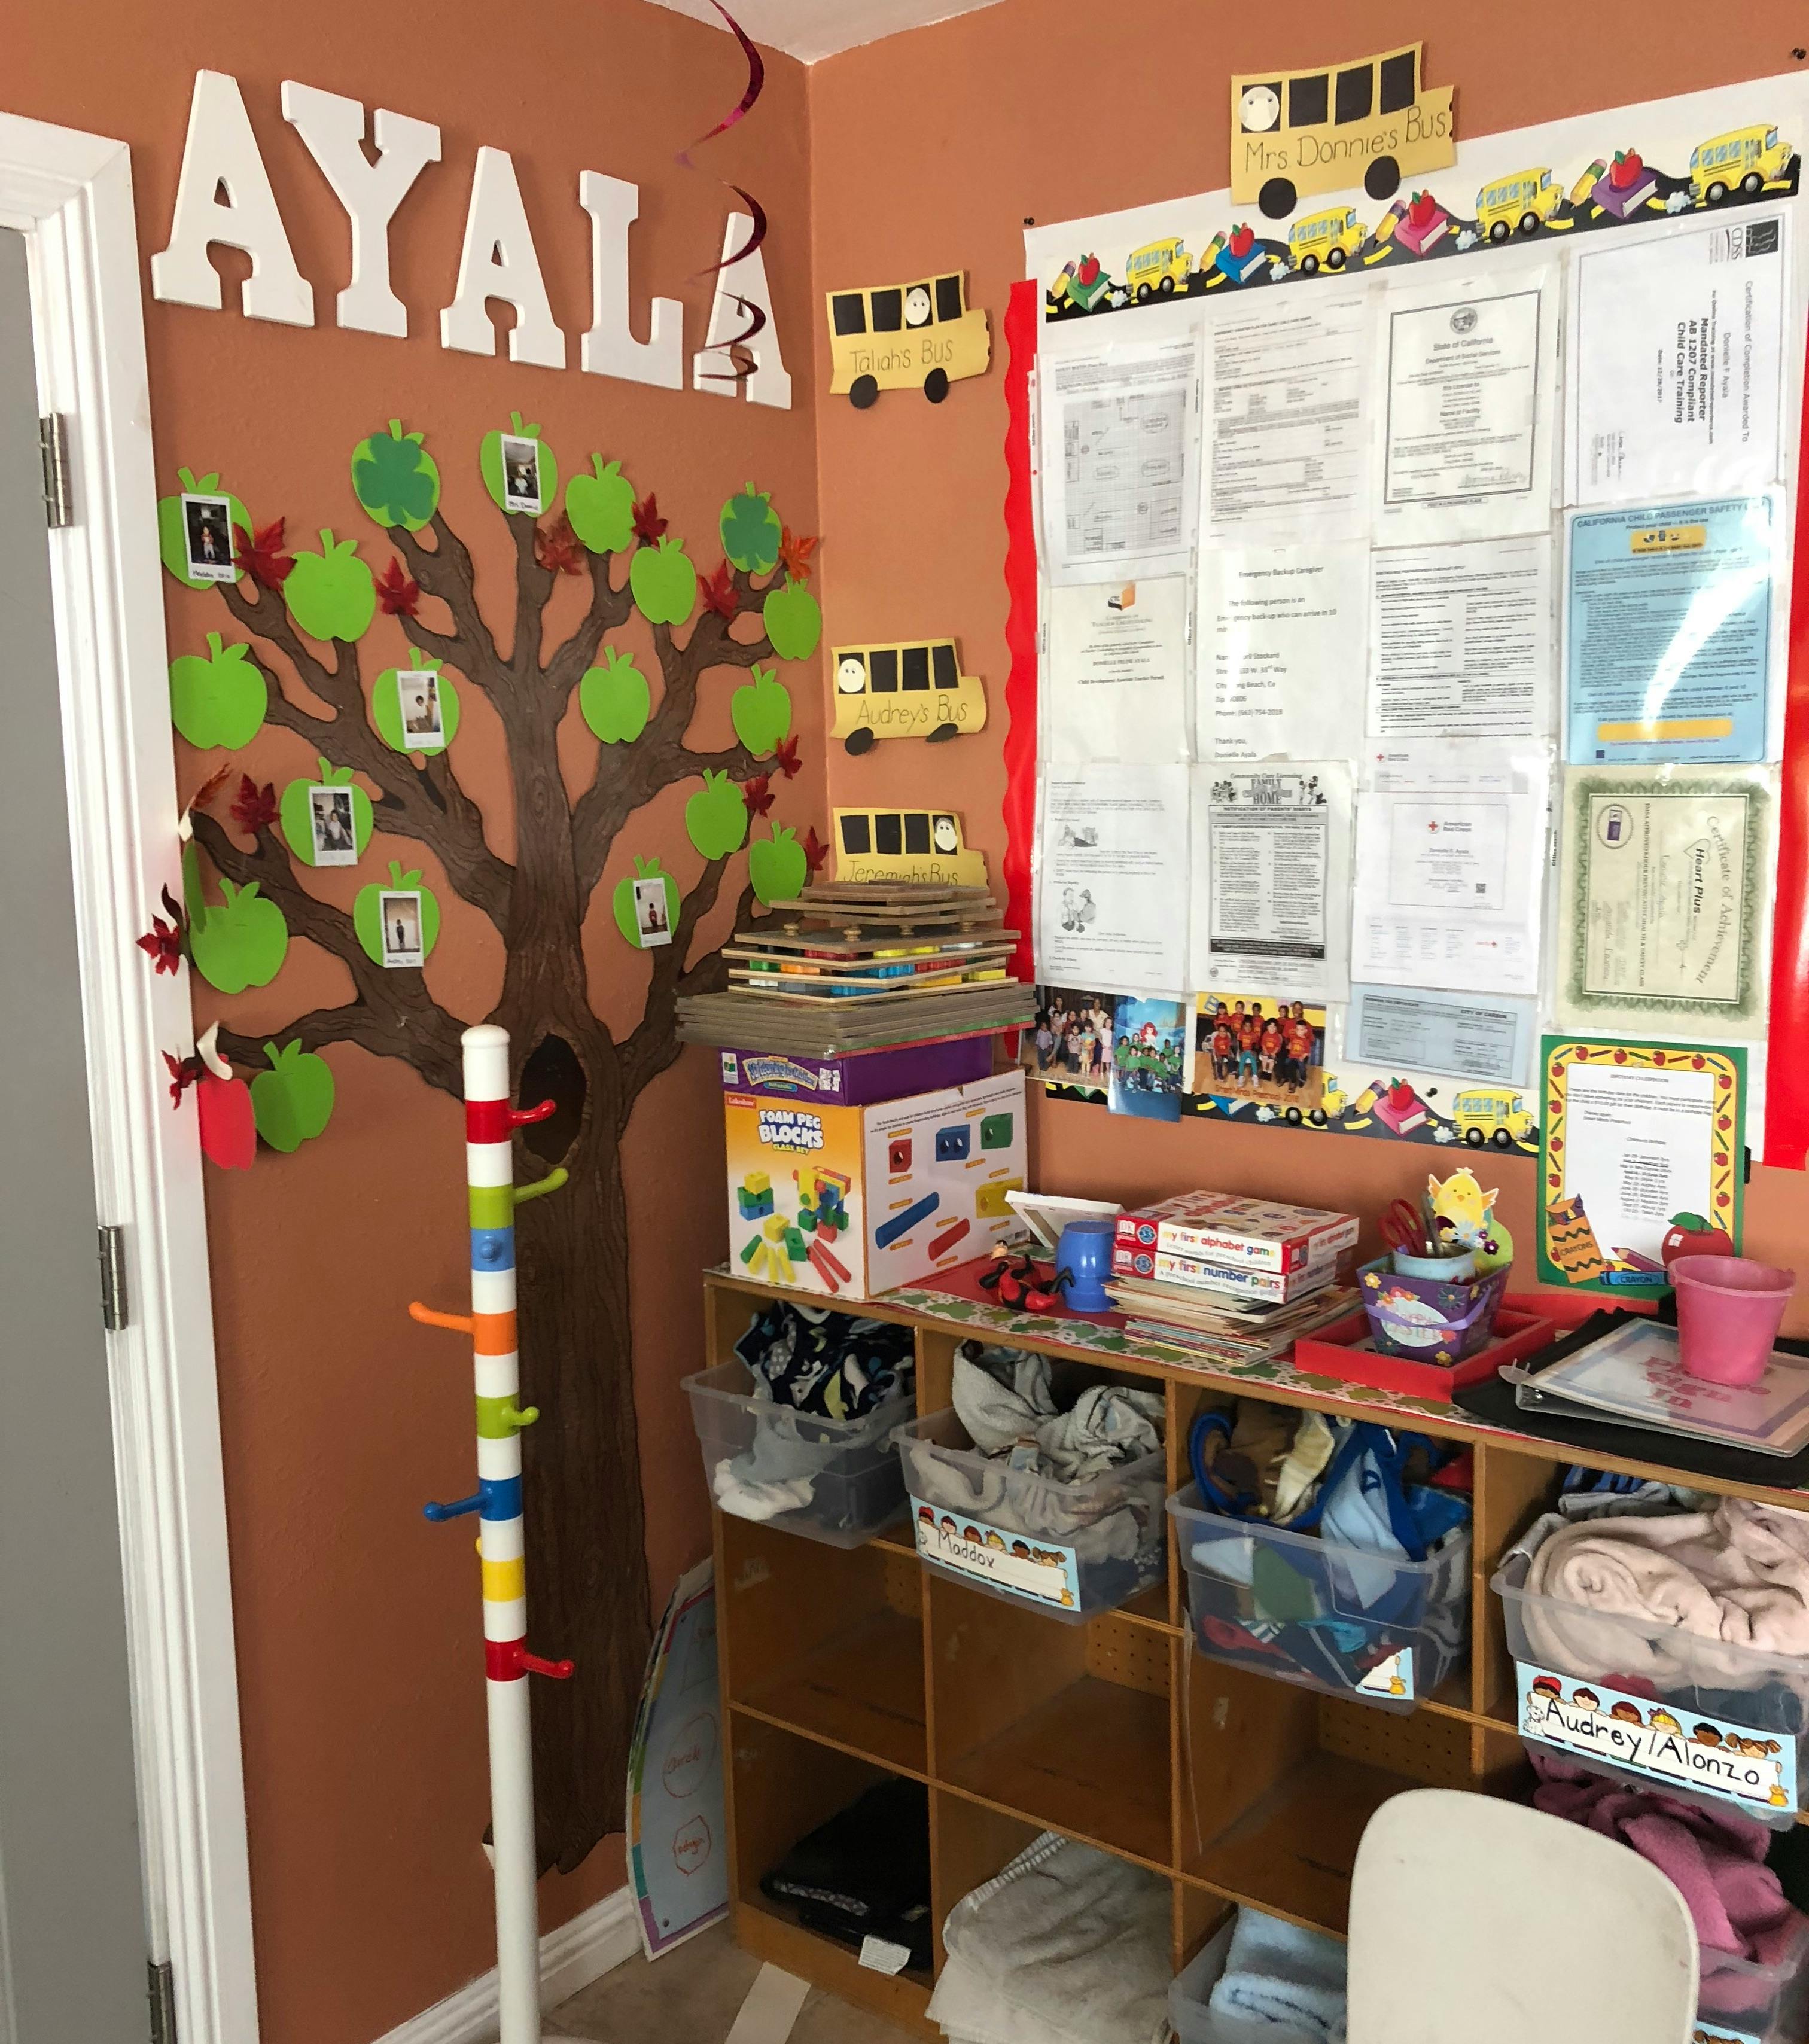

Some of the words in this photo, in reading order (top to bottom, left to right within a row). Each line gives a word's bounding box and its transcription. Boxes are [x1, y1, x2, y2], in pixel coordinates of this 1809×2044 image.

[1297, 128, 1398, 167] Donnie's
[1405, 105, 1447, 144] Bus
[151, 68, 792, 410] AYALA
[1732, 228, 1743, 260] CDSS
[1744, 281, 1753, 330] Certification
[1677, 322, 1686, 349] Child
[1689, 320, 1697, 334] AB
[849, 349, 911, 374] Taliah's
[921, 339, 954, 365] Bus
[1433, 343, 1451, 351] State
[1461, 337, 1494, 347] California
[1688, 339, 1697, 365] 1207
[1700, 318, 1709, 370] Mandated
[1677, 352, 1685, 376] Care
[1743, 345, 1752, 391] Completion
[1674, 379, 1685, 424] Training
[1686, 368, 1697, 422] Compliant
[1697, 373, 1708, 421] Reporter
[1721, 376, 1730, 398] Ayala
[1742, 394, 1750, 428] Awarded
[1742, 432, 1750, 442] To
[1577, 516, 1626, 528] CALIFORNIA
[1655, 507, 1707, 520] PASSENGER
[1709, 504, 1743, 514] SAFETY
[855, 699, 930, 734] Audrey's
[936, 694, 969, 723] Bus
[1253, 791, 1282, 805] HOME
[1707, 816, 1732, 881] Certificate
[843, 860, 927, 884] Jeremiah's
[929, 863, 958, 885] Bus
[1694, 848, 1705, 884] Heart
[1692, 885, 1704, 914] Plus
[1722, 887, 1734, 900] of
[1695, 904, 1734, 985] Achievement
[759, 1110, 794, 1125] FOAM
[796, 1112, 823, 1129] PEG
[758, 1124, 825, 1149] BLOCKS
[773, 1143, 794, 1152] CLASS
[796, 1146, 810, 1155] SET
[1162, 1230, 1178, 1241] my
[1180, 1232, 1199, 1244] first
[1201, 1236, 1244, 1251] alphabet
[1247, 1246, 1275, 1257] game
[1560, 1242, 1592, 1256] CRAYONS
[1158, 1259, 1175, 1271] my
[1178, 1260, 1201, 1274] first
[1203, 1266, 1248, 1283] number
[1251, 1275, 1281, 1290] pairs
[1621, 1275, 1653, 1284] CRAYON
[937, 1528, 995, 1568] Maddox
[1546, 1698, 1760, 1786] Audrey/Alonzo
